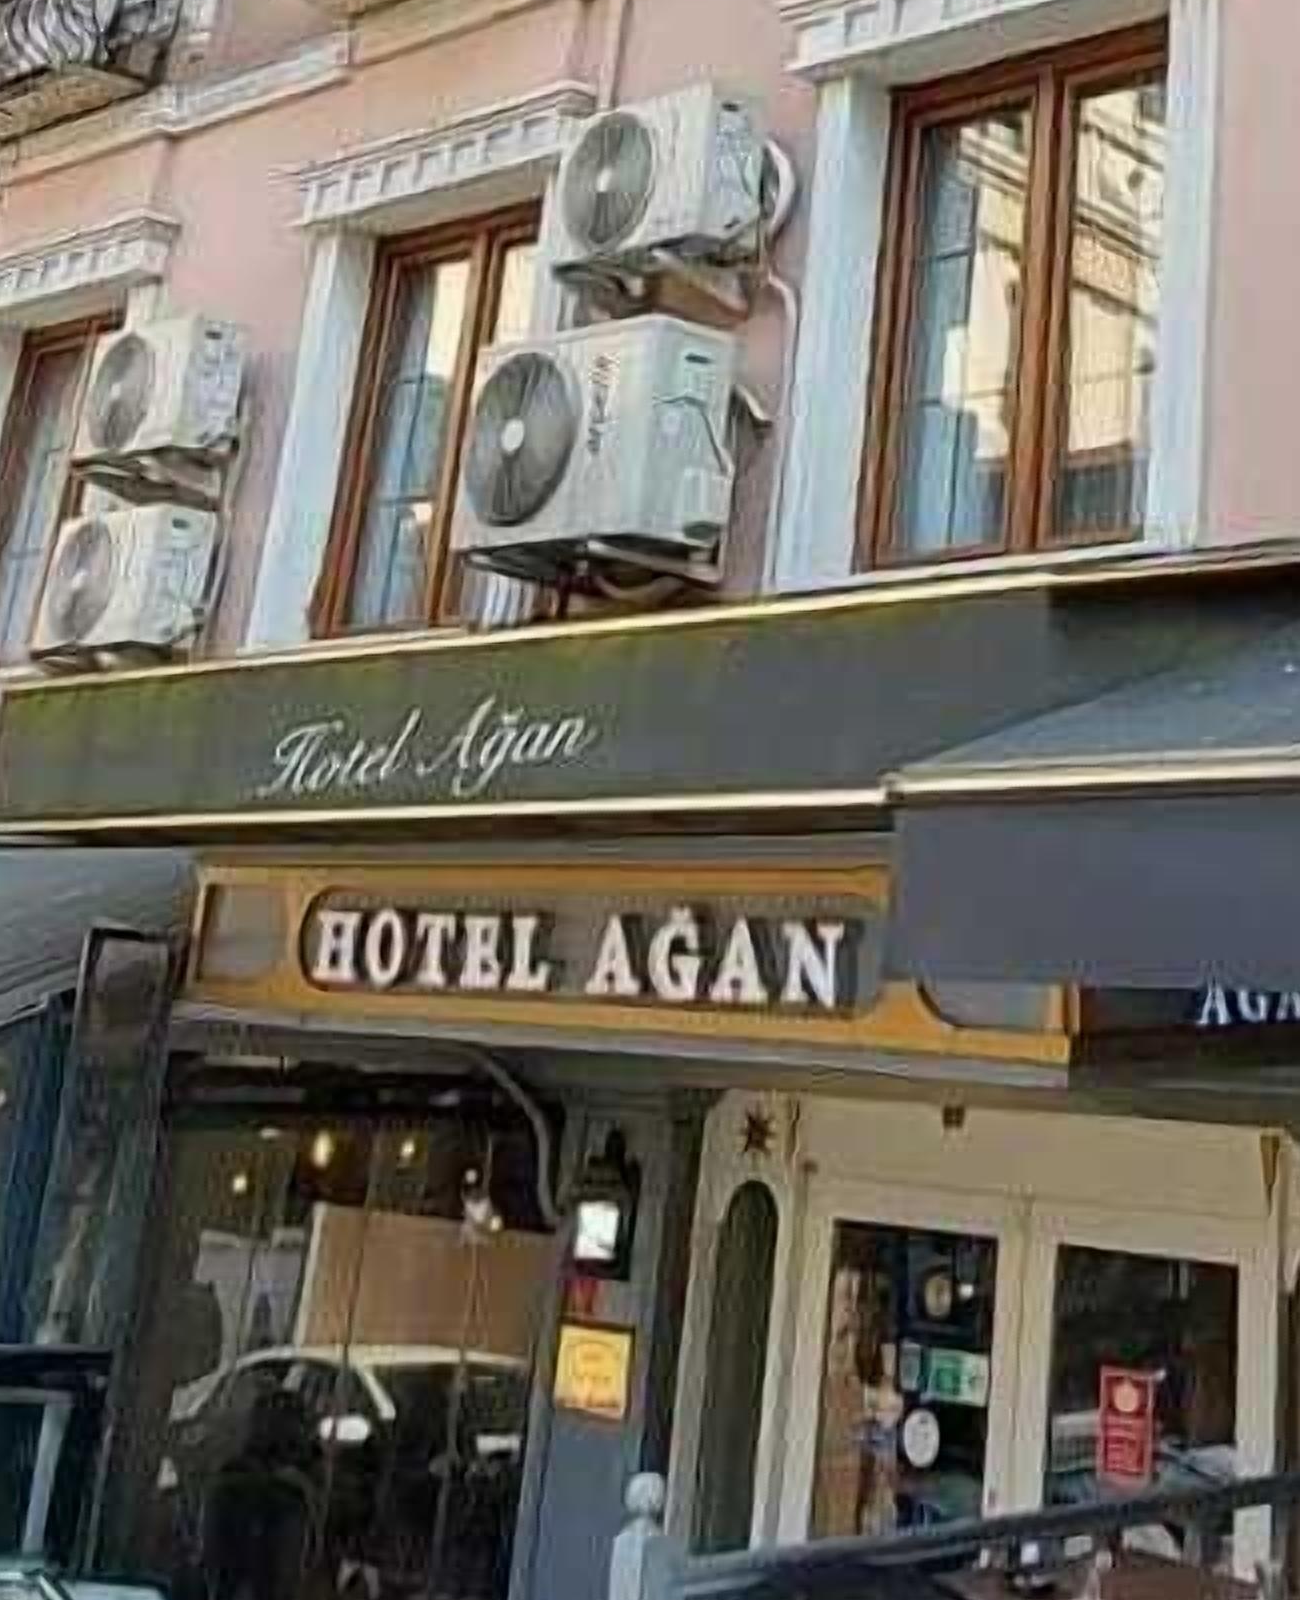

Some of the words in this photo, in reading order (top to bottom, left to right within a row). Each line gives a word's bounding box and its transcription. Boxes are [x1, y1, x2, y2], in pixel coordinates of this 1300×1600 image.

[250, 705, 423, 797] Hotel
[414, 693, 598, 798] Ağan
[311, 907, 552, 992] HOTEL
[583, 905, 847, 1010] AĞAN
